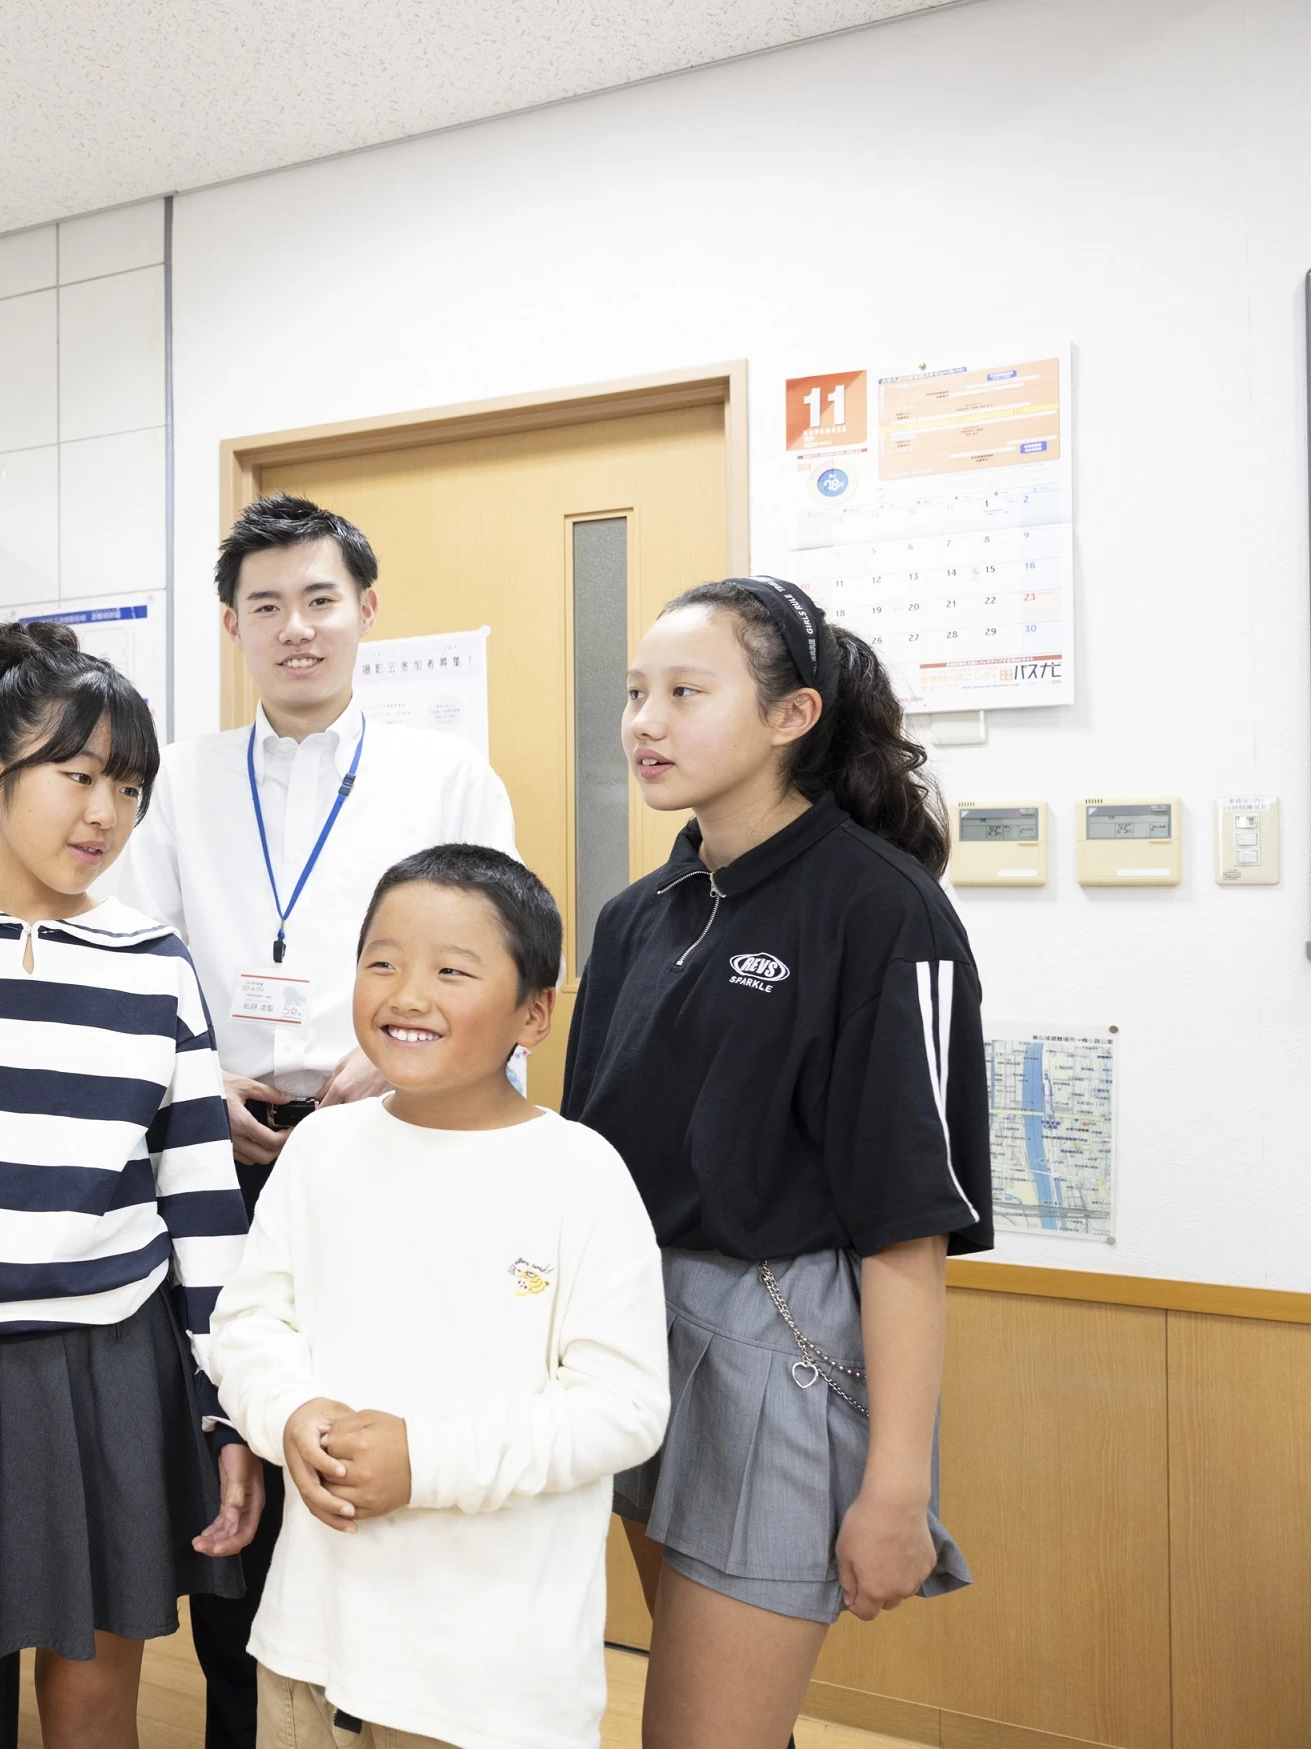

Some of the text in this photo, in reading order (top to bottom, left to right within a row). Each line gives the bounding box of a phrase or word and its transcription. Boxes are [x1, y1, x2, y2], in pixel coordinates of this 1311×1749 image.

[803, 385, 847, 428] 11
[908, 543, 914, 551] 6
[946, 539, 951, 548] 7
[984, 535, 990, 544] 8
[1024, 531, 1030, 540] 9
[835, 580, 844, 588] 11
[872, 576, 881, 585] 12
[908, 572, 919, 581] 13
[946, 568, 957, 577] 14
[984, 564, 995, 573] 15
[1024, 561, 1035, 570] 16
[784, 594, 803, 613] RULE
[835, 592, 1036, 617] 18 19 20 21 22 23
[798, 610, 814, 635] GIRLS
[872, 624, 1037, 644] 26 27 28 29 30
[1014, 662, 1062, 680] パスナビ
[729, 976, 774, 993] SPARKLE
